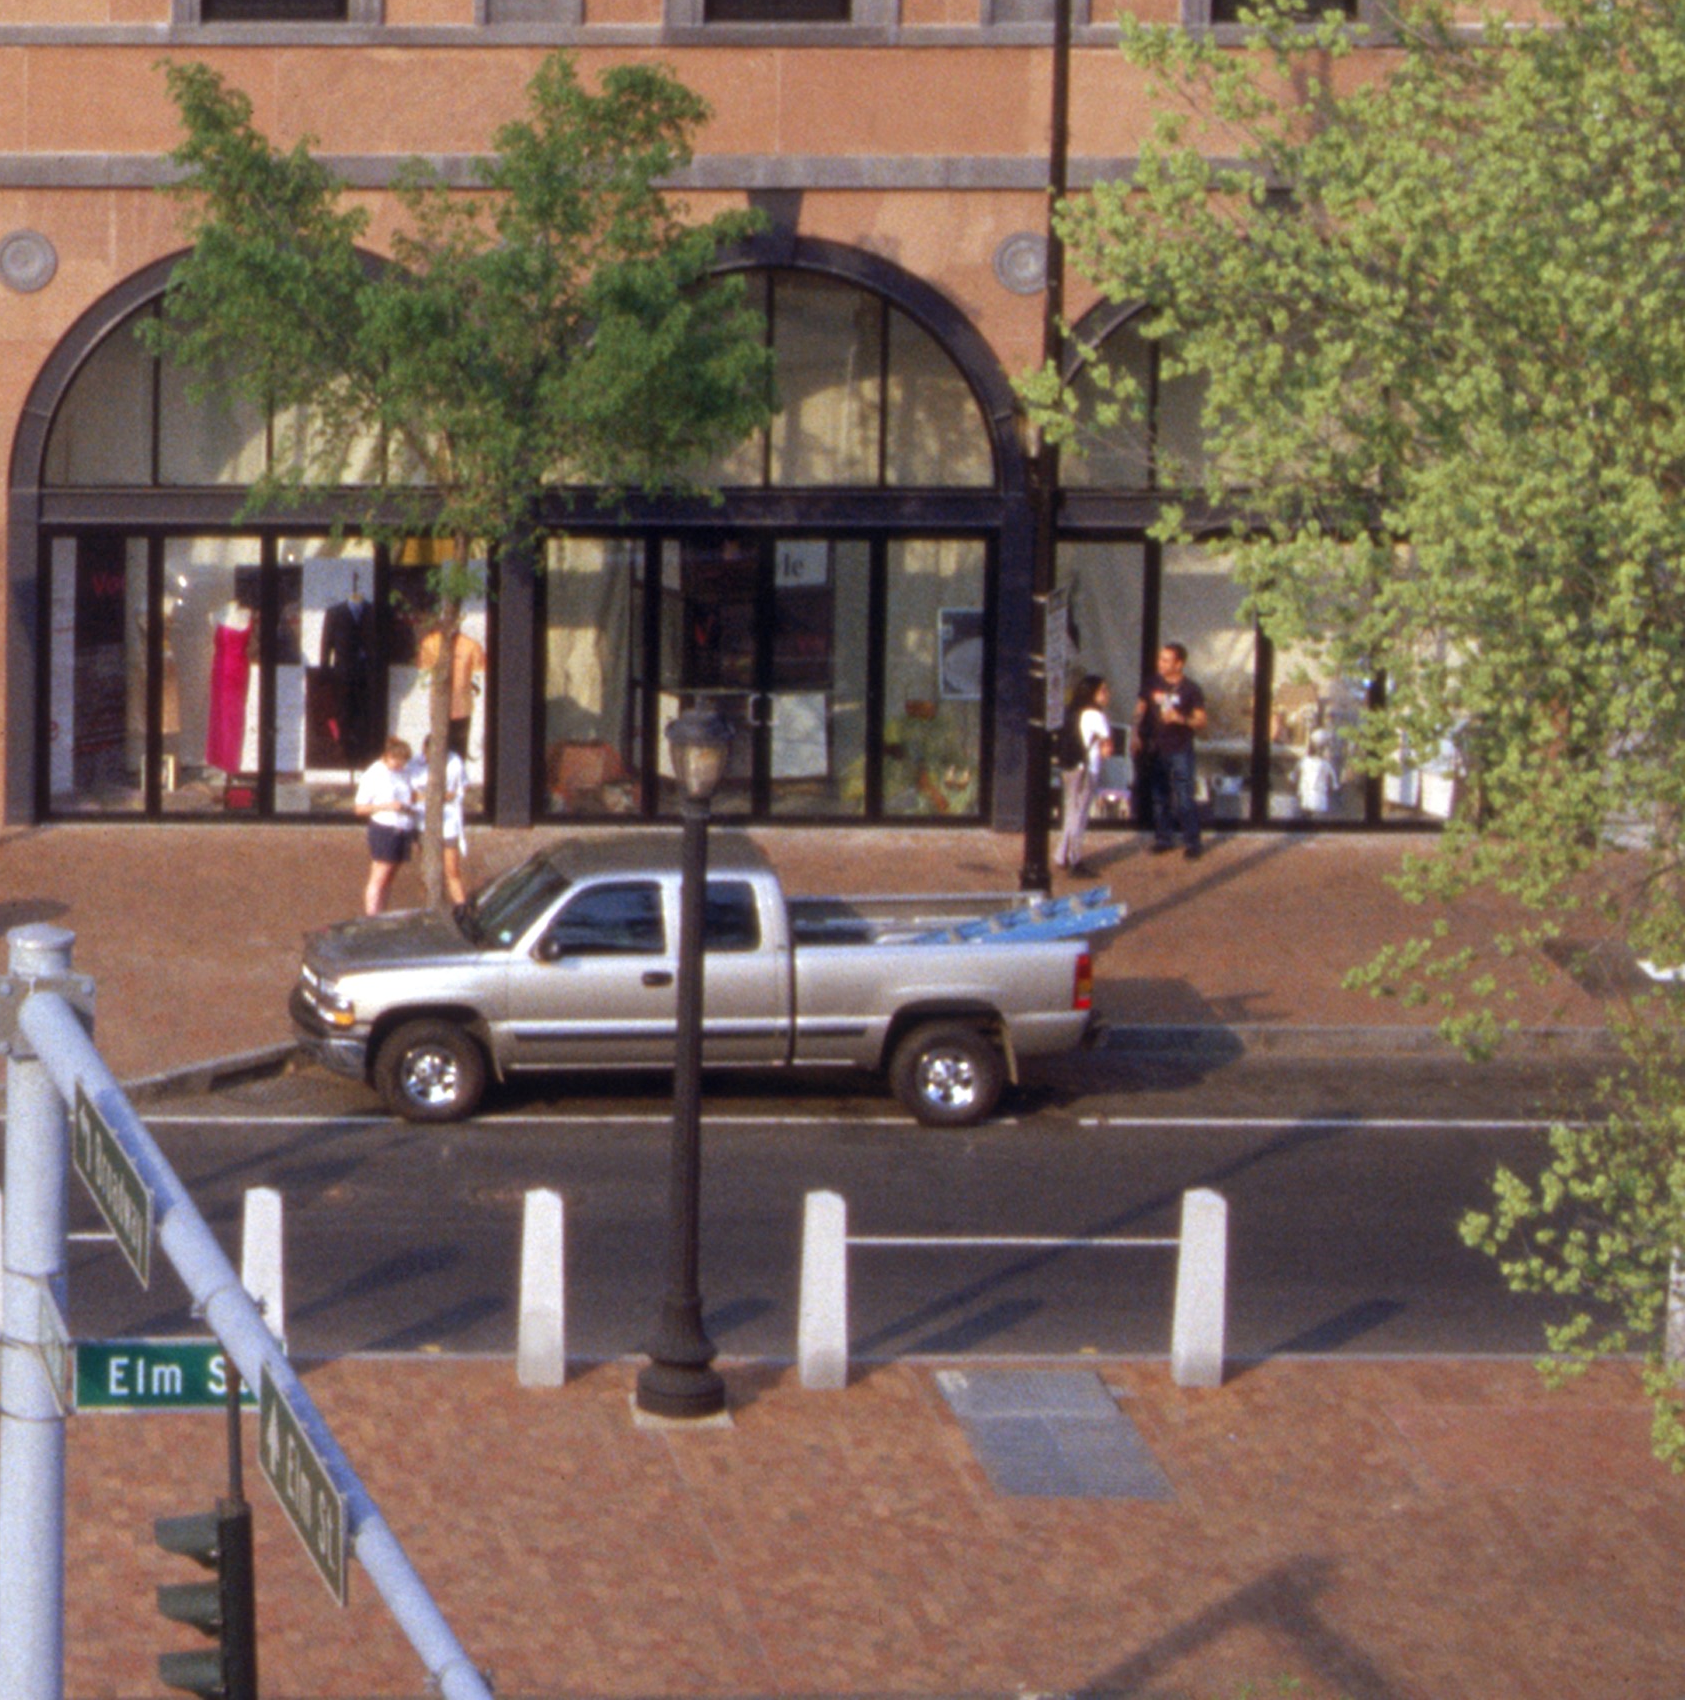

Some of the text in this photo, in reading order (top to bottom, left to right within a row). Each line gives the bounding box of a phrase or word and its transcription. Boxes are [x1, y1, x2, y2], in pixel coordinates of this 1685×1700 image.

[109, 1355, 183, 1396] Elm
[286, 1432, 337, 1571] Elm St
